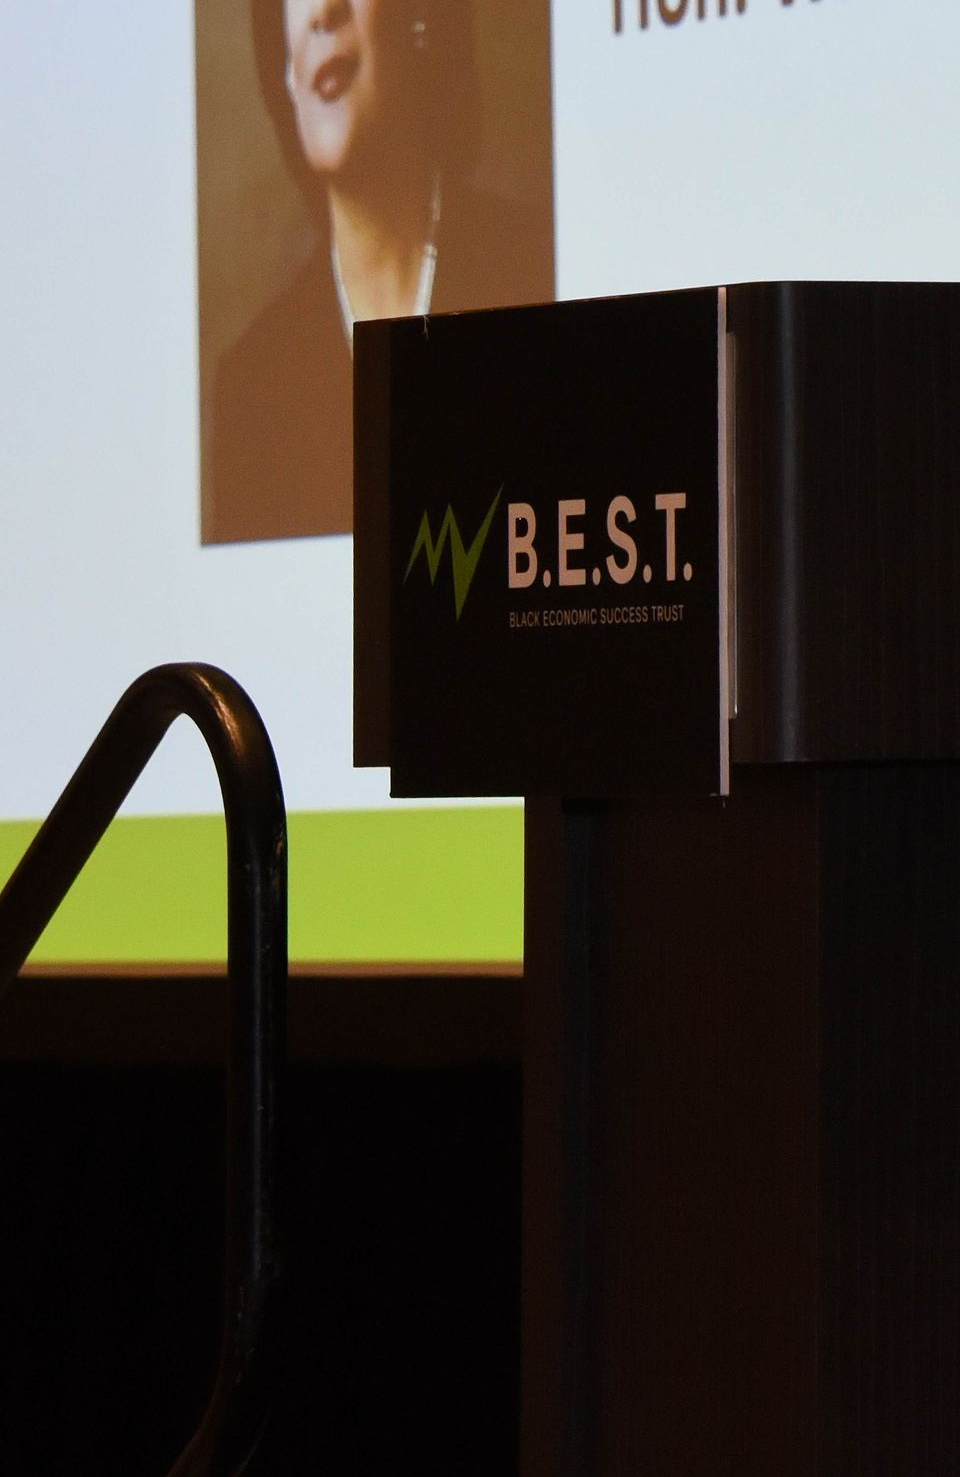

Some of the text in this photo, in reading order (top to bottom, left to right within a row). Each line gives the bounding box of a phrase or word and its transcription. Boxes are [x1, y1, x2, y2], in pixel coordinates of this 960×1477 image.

[507, 492, 693, 589] B.E.S.T.
[508, 604, 685, 628] BLACK ECONOMIC SUCCESS TRUST
